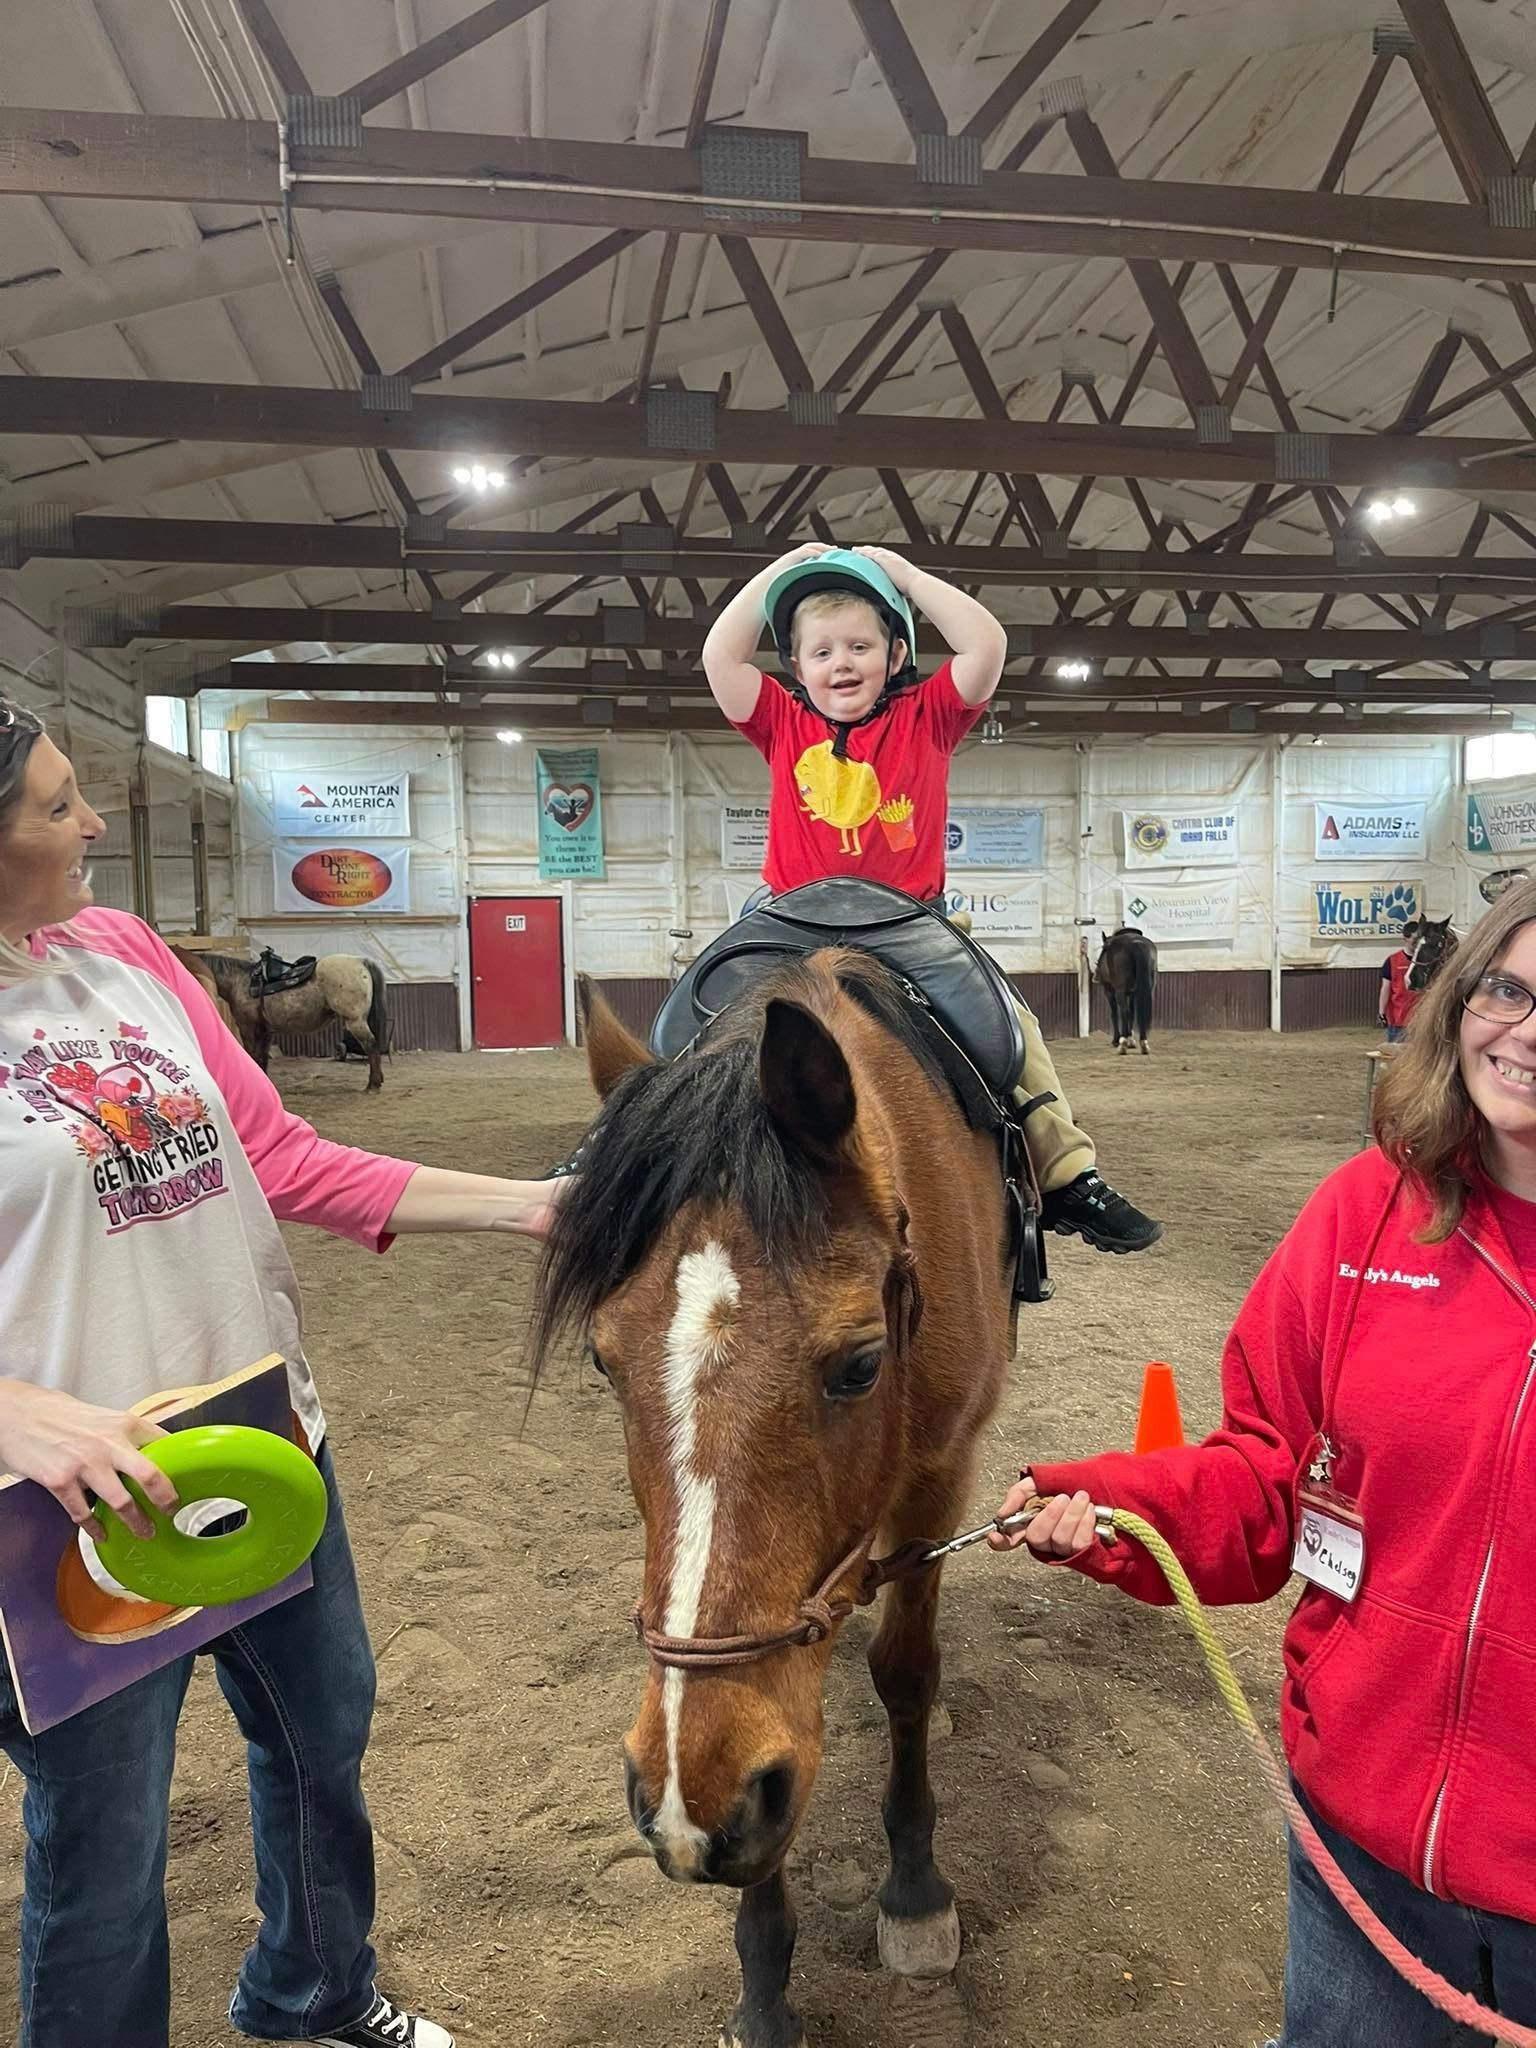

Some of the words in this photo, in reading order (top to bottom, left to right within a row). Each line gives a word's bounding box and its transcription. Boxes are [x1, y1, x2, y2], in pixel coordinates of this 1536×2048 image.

[326, 785, 400, 796] MOUNTAIN
[331, 797, 396, 808] AMERICA
[314, 814, 366, 823] CENTER
[726, 808, 753, 818] Taylor
[1204, 817, 1223, 828] CLUB
[1225, 816, 1235, 827] OF
[1342, 816, 1403, 830] ADAMS
[1205, 830, 1228, 841] FALLS
[1348, 830, 1400, 839] INSULATION
[1402, 831, 1420, 839] LLC
[544, 855, 557, 863] BE
[558, 855, 572, 863] the
[573, 855, 598, 863] BEST
[336, 870, 371, 885] RIGHT
[311, 890, 374, 898] CONTRACTOR
[951, 894, 1007, 913] CHC
[1151, 896, 1201, 909] Mountain
[1202, 895, 1230, 906] View
[1315, 891, 1384, 925] WOLF
[1168, 907, 1211, 920] Hospital
[507, 917, 524, 929] EXIT
[1318, 925, 1376, 936] COUNTRY'S
[1378, 923, 1404, 935] BES
[48, 1039, 102, 1062] LIKE
[109, 1040, 190, 1084] YOU'RE
[93, 1147, 164, 1194] GETING
[160, 1122, 219, 1171] FRIED
[98, 1157, 224, 1226] TOMORROW
[1338, 1263, 1389, 1284] Emly's
[1389, 1270, 1441, 1289] Angels
